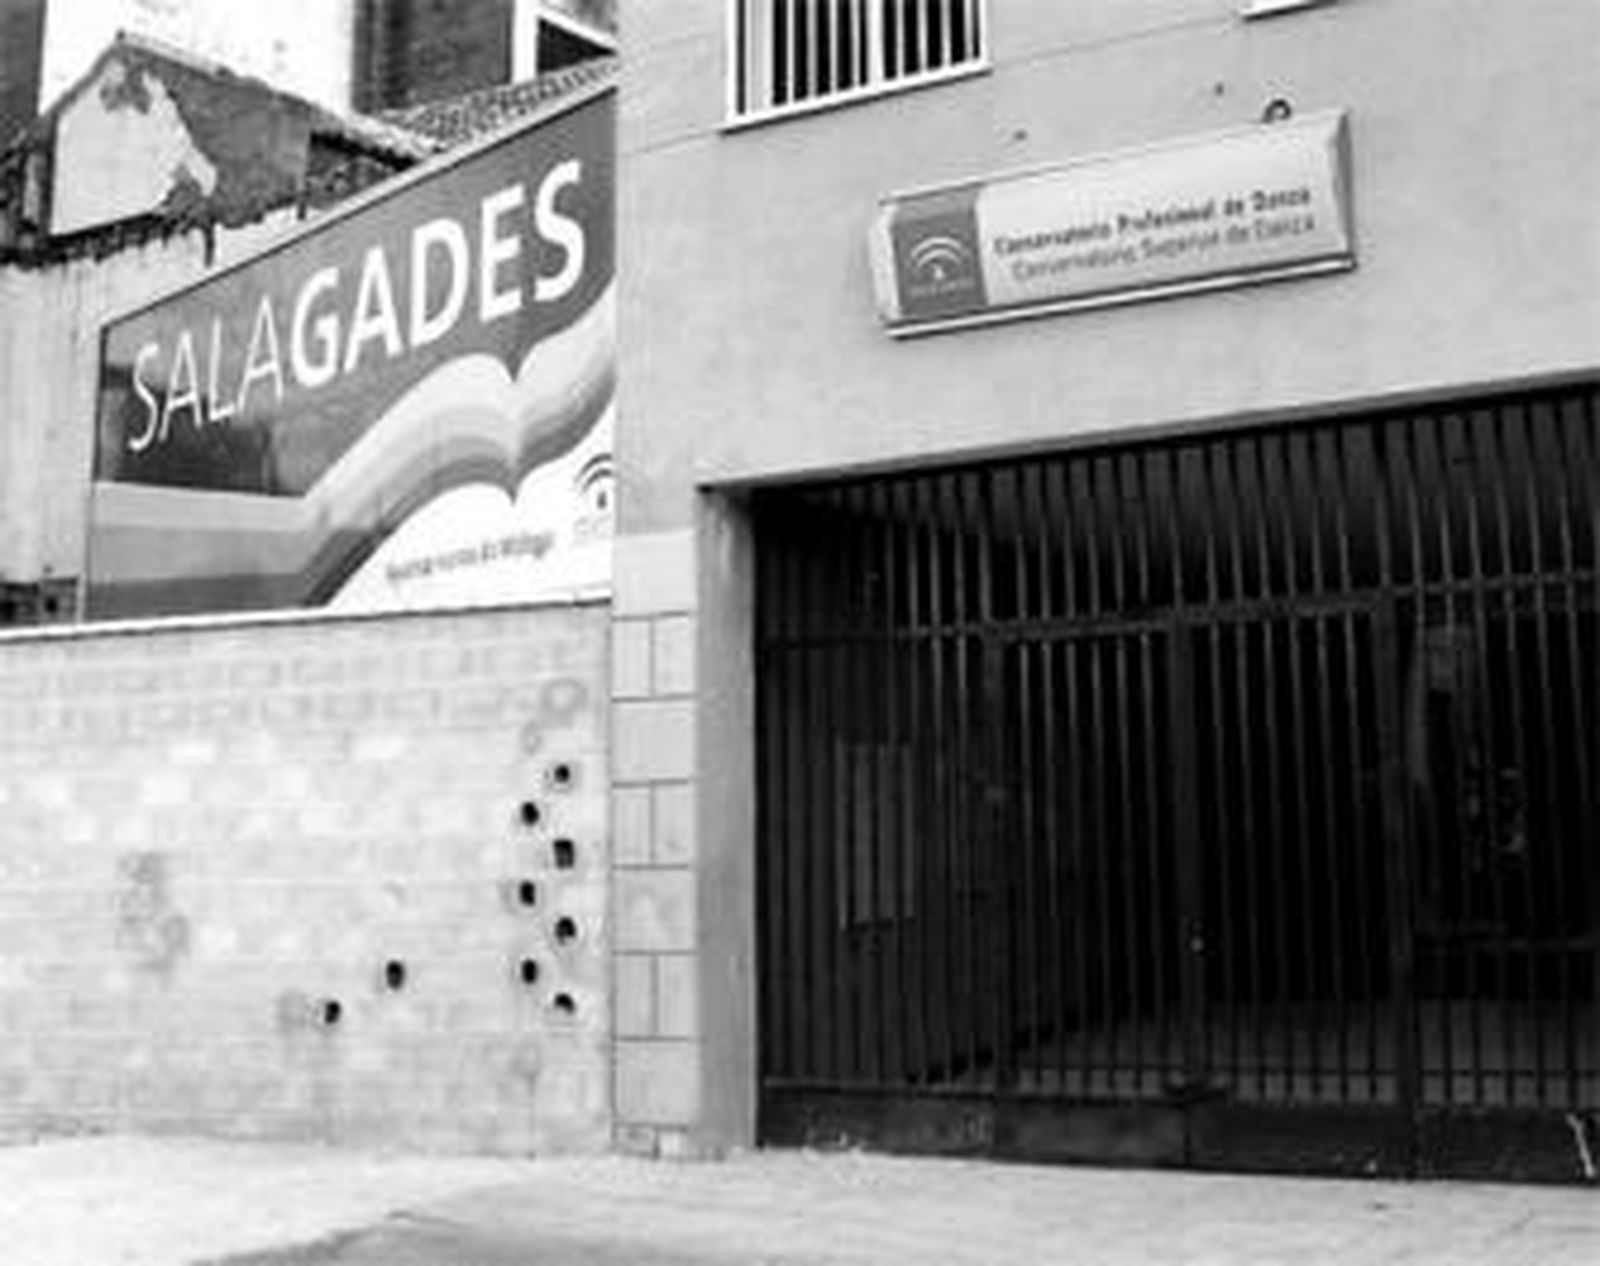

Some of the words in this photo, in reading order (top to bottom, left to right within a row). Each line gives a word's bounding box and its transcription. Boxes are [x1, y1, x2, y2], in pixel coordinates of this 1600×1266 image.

[994, 222, 1112, 257] Conservatorio
[1224, 198, 1245, 217] de
[1252, 188, 1311, 212] Danza
